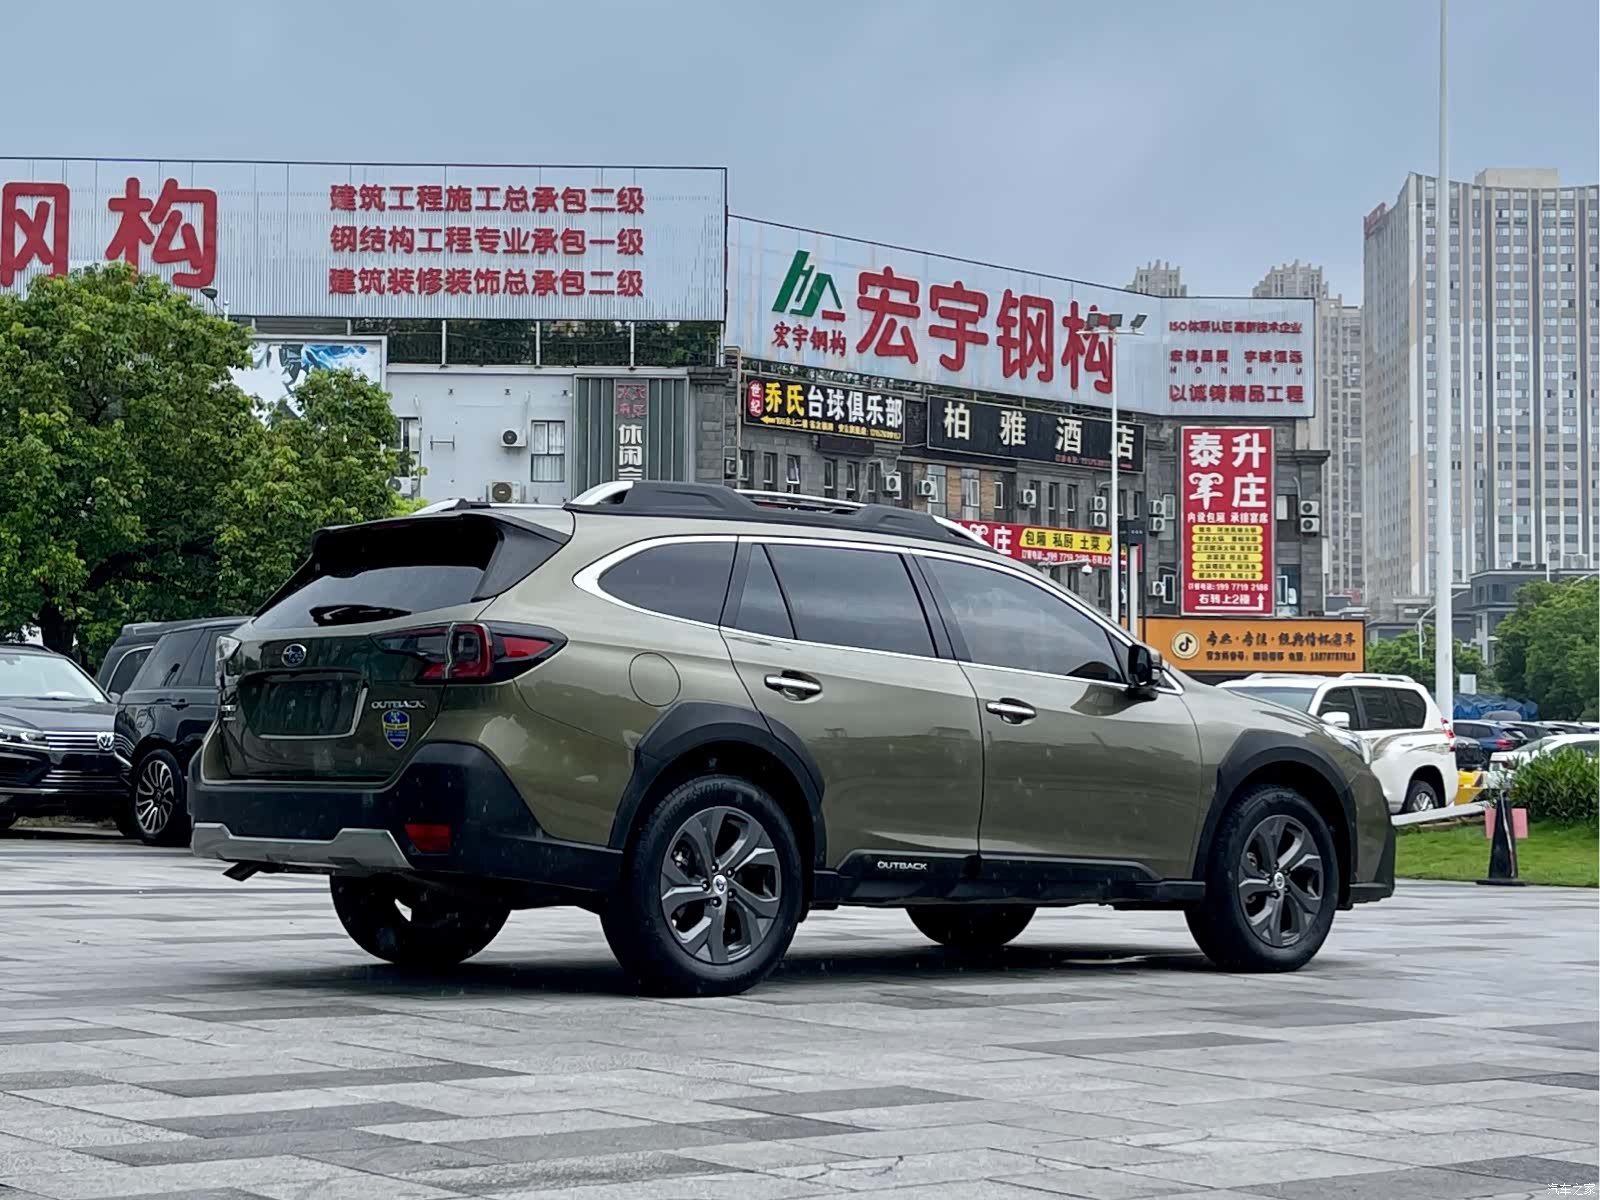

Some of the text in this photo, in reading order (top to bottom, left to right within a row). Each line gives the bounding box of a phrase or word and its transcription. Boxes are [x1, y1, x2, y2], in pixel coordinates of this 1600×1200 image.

[329, 183, 645, 215] 建筑工程施工总承包二级
[330, 224, 644, 258] 钢结构工程专业承包一级
[329, 266, 644, 298] 建筑装修装饰总承包二级
[772, 321, 847, 358] 宏宇钢构
[856, 266, 1115, 394] 宏宇钢构
[750, 384, 762, 414] 世纪
[765, 381, 903, 429] 乔氏台球俱乐部
[1169, 384, 1305, 403] 以诚铸精品工程
[944, 401, 1134, 460] 柏雅酒店
[1188, 431, 1267, 469] 泰升
[1025, 531, 1046, 546] 包厢
[1052, 532, 1074, 549] 私厨
[1080, 535, 1100, 551] 土菜
[371, 699, 426, 710] OUTBACK
[877, 860, 928, 871] OUTBACK
